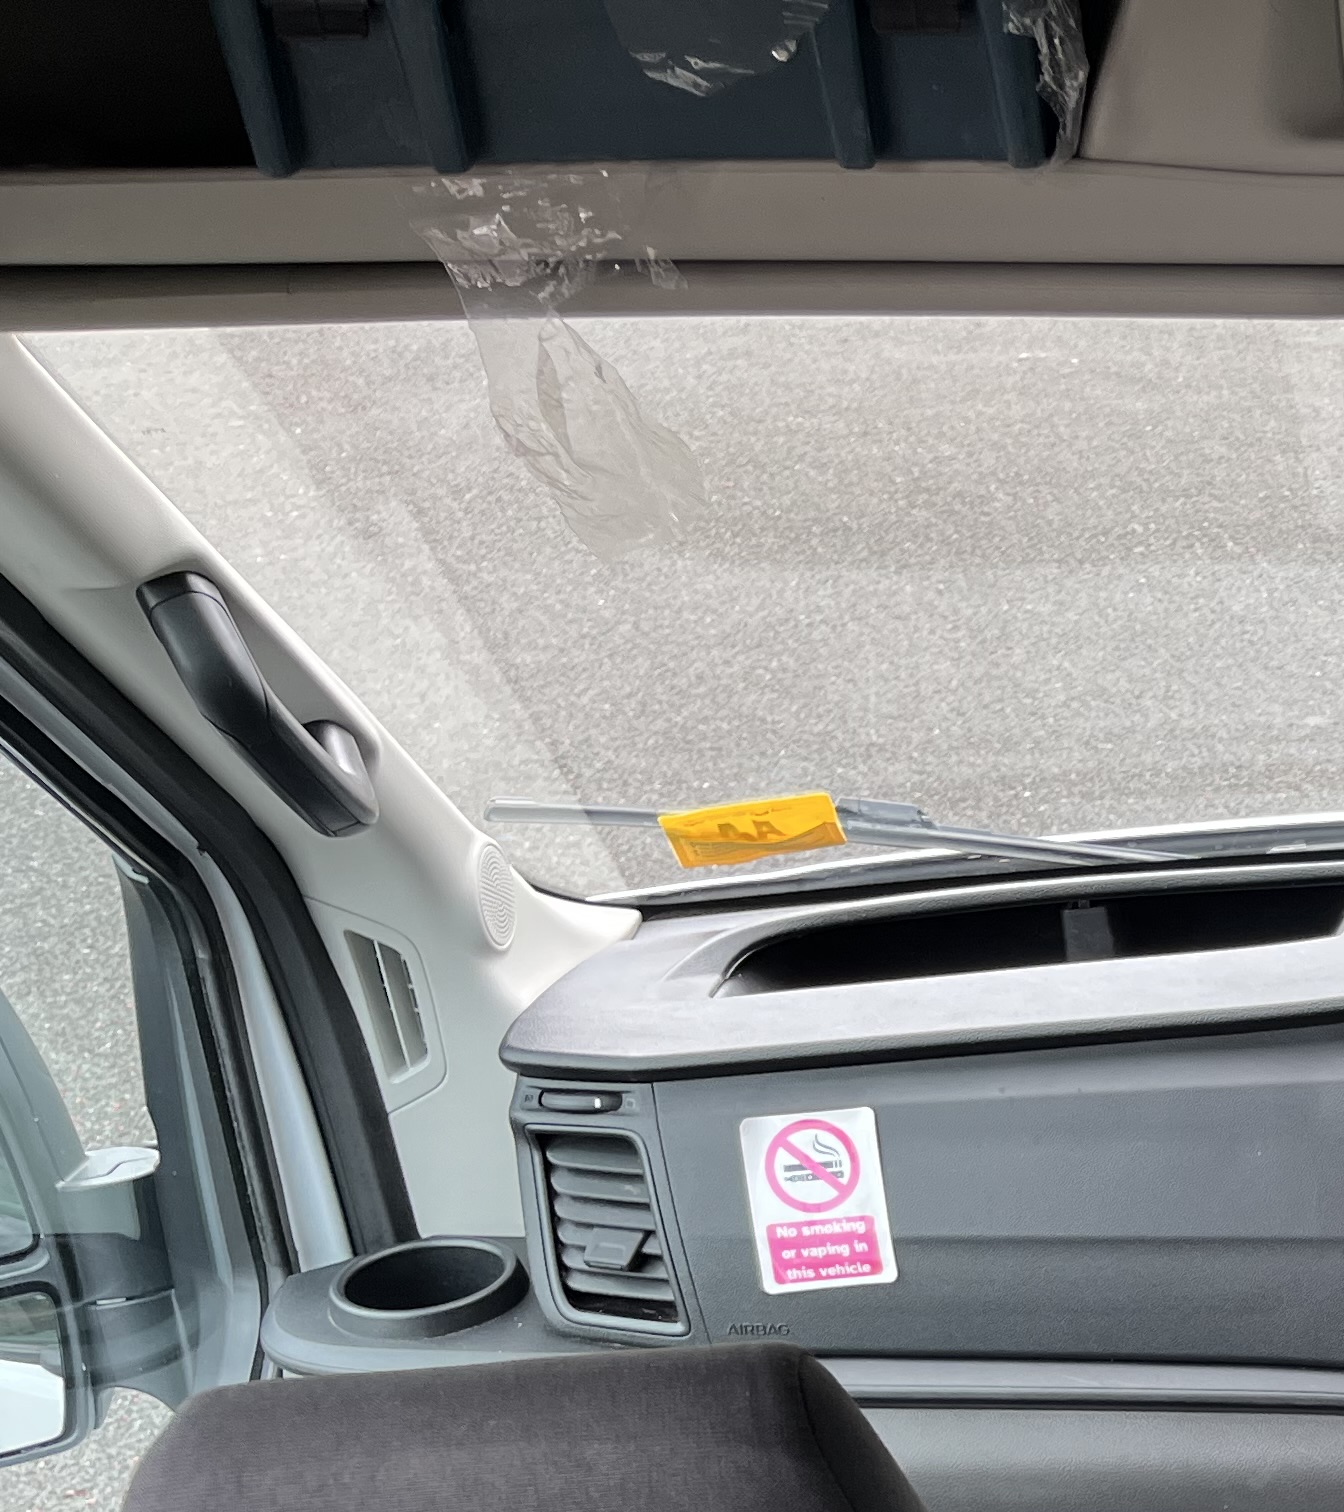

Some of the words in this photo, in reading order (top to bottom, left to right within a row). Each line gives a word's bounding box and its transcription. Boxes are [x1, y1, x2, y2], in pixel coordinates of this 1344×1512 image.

[775, 1226, 798, 1239] No
[801, 1219, 866, 1235] smoking
[781, 1248, 797, 1260] or
[800, 1242, 850, 1259] vaping
[853, 1240, 869, 1253] in
[786, 1266, 816, 1281] this
[818, 1262, 872, 1278] vehicle
[727, 1322, 791, 1337] AIRBAG
